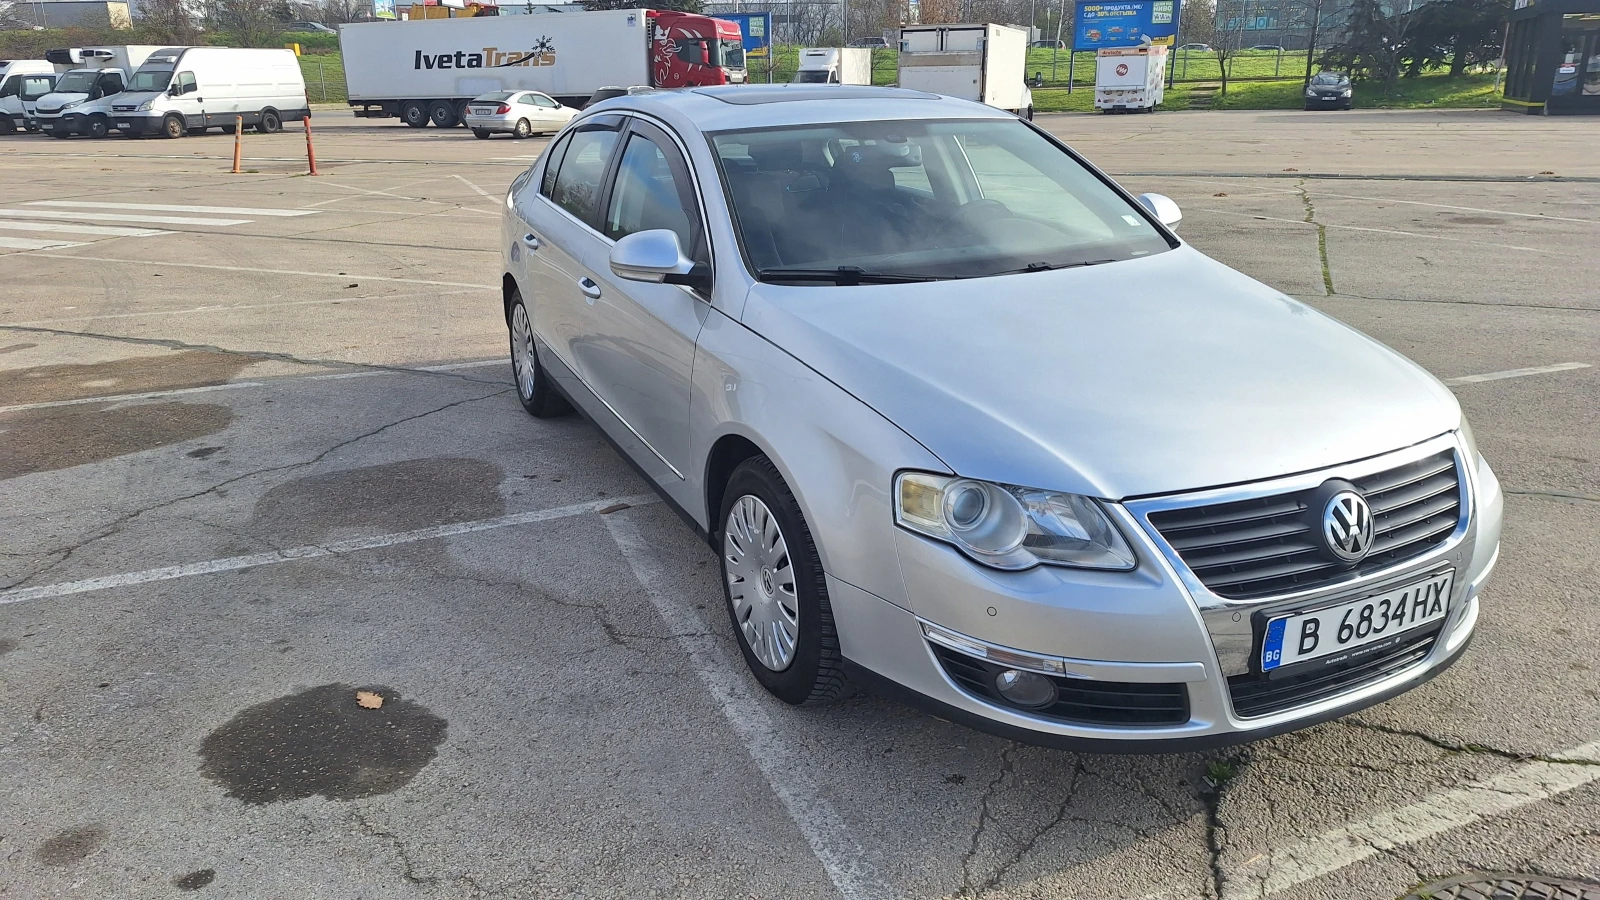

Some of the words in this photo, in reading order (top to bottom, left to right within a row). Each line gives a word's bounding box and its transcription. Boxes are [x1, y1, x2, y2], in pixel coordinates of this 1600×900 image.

[414, 47, 556, 69] IvetaTrans
[1297, 617, 1321, 655] B
[1265, 651, 1280, 663] BG
